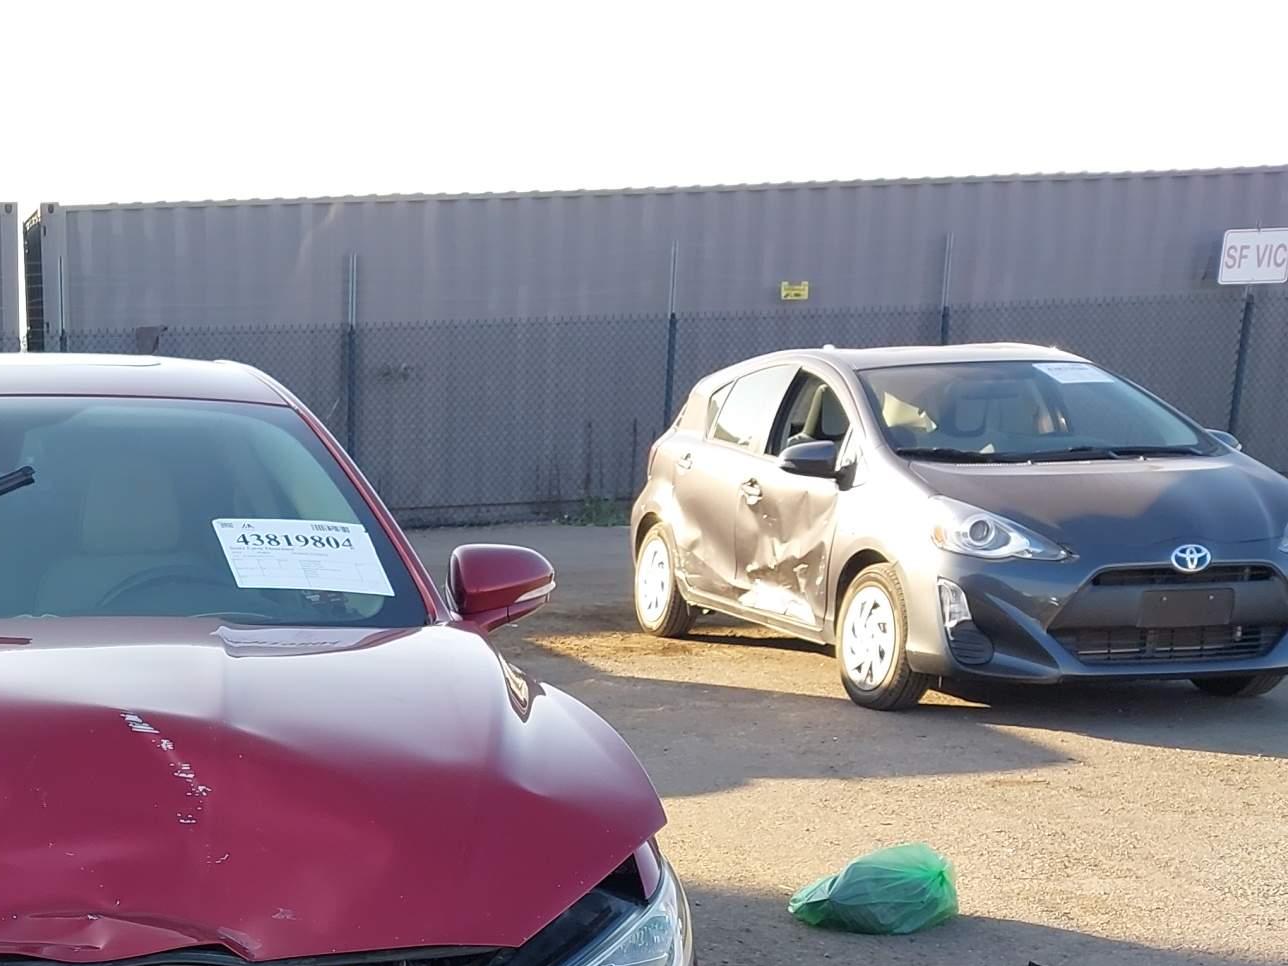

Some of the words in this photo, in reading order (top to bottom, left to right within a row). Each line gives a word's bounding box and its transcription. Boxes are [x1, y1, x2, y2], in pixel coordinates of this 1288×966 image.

[1224, 245, 1251, 269] SF
[1256, 243, 1288, 269] VIC
[235, 533, 354, 549] 43819804
